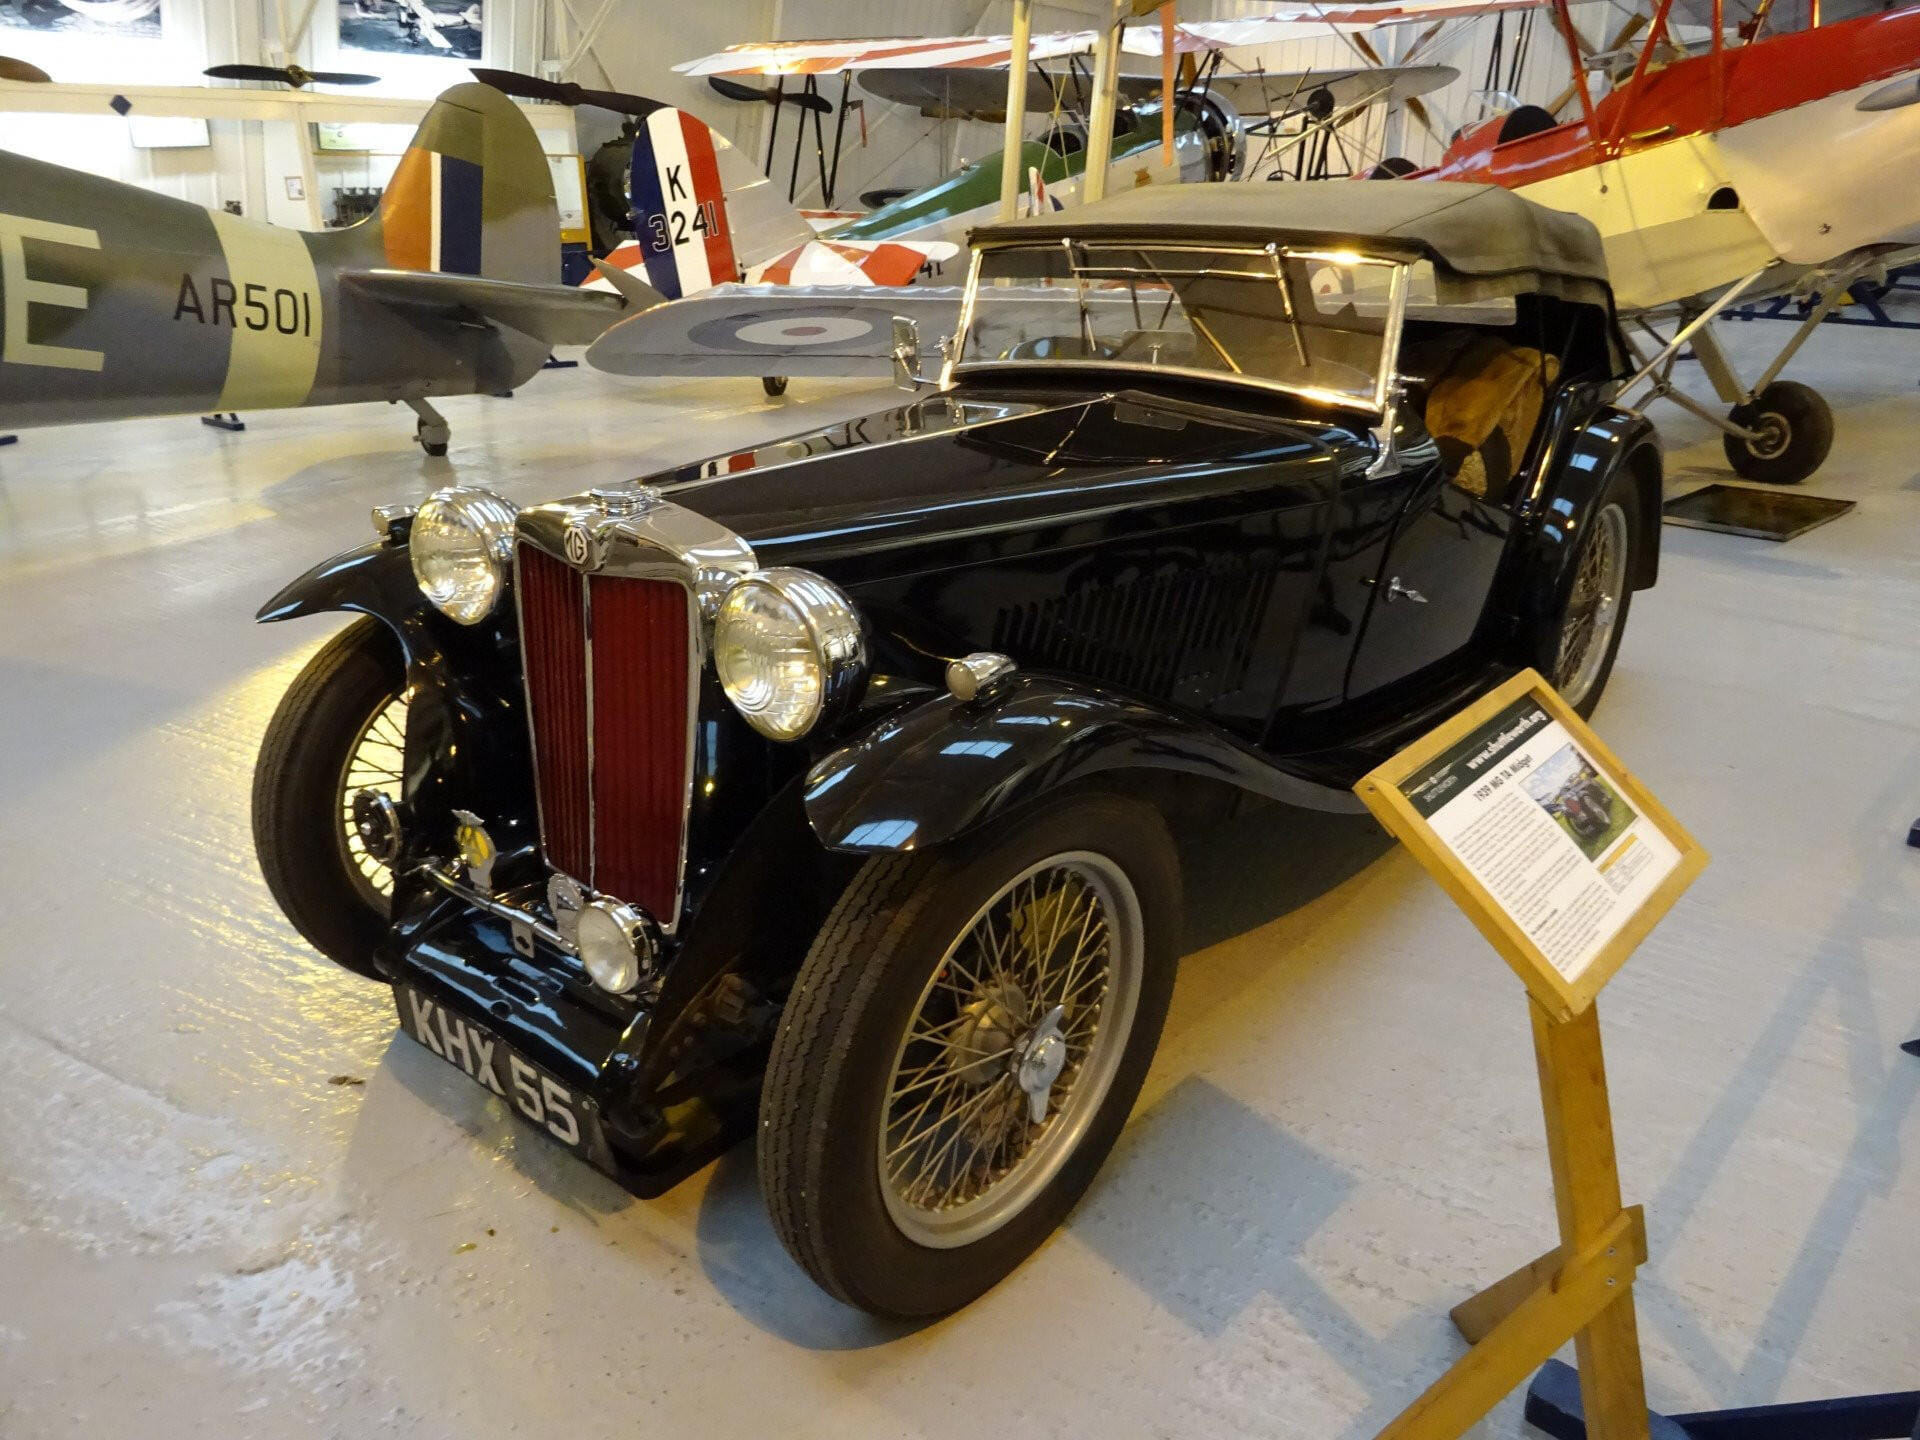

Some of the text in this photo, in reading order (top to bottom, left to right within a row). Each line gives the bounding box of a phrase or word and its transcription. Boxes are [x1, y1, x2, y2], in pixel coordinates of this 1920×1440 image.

[666, 165, 687, 202] K
[648, 201, 719, 252] 3241
[0, 212, 105, 372] E
[173, 273, 311, 337] AR501
[1511, 753, 1534, 775] Midget
[409, 989, 580, 1146] KHX 55
